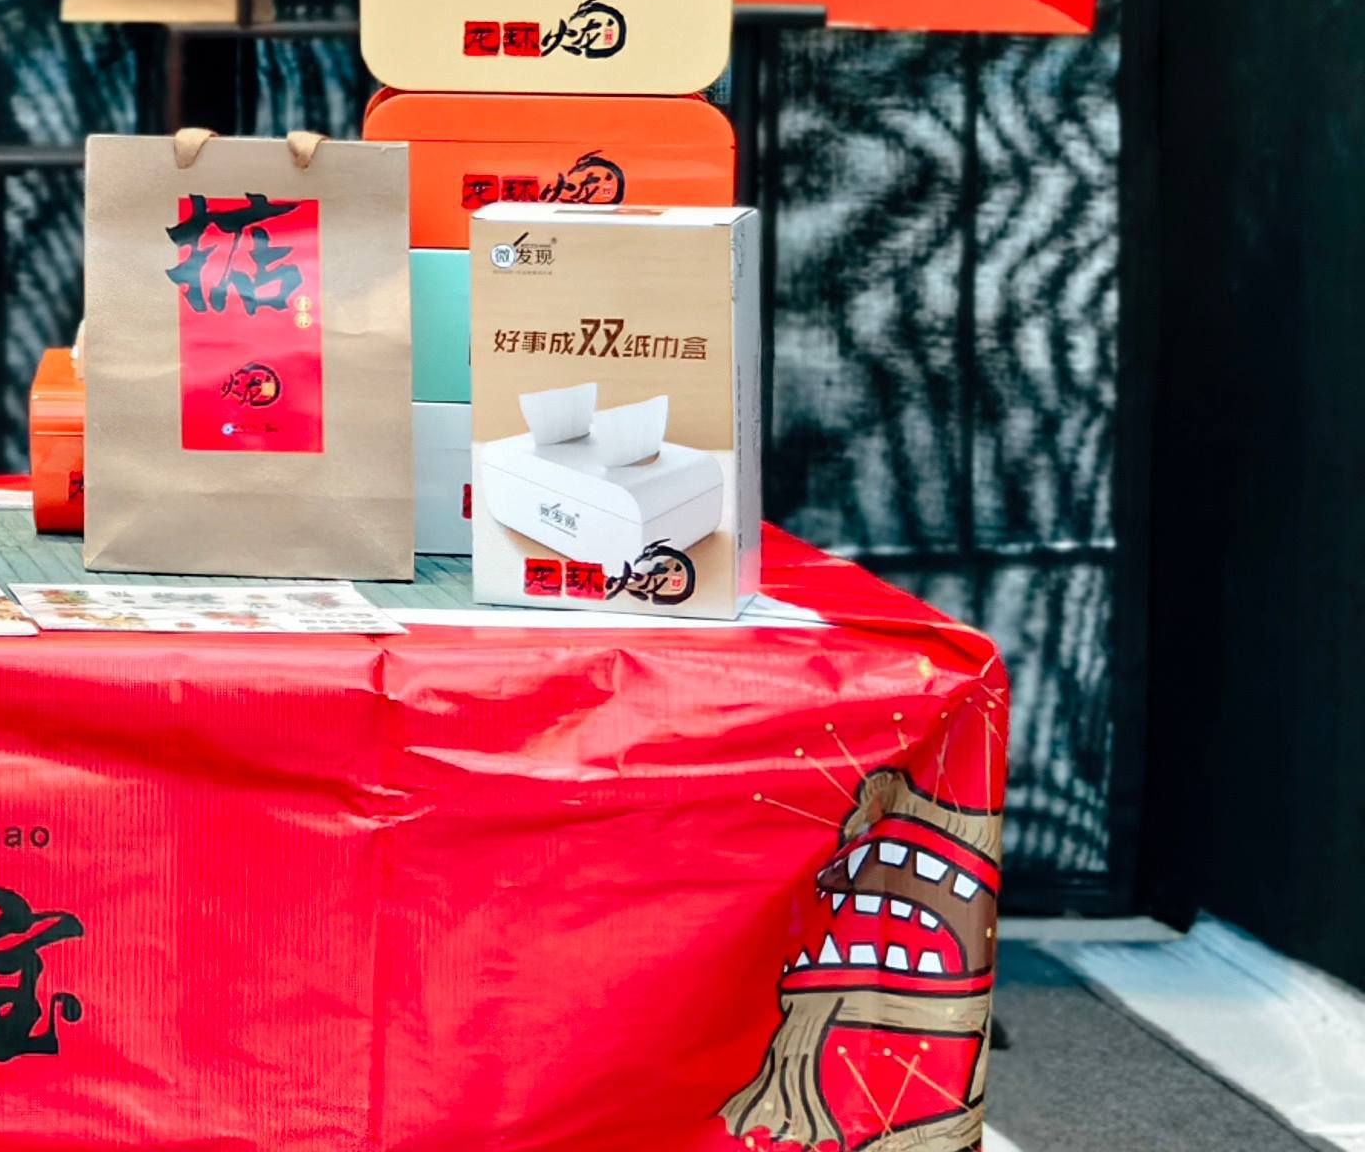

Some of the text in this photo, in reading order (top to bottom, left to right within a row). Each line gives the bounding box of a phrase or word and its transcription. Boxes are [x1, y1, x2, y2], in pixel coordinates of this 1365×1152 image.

[492, 245, 555, 268] 微发现
[494, 319, 709, 360] 好事成双纸巾盒
[524, 539, 696, 605] 龙环火龙
